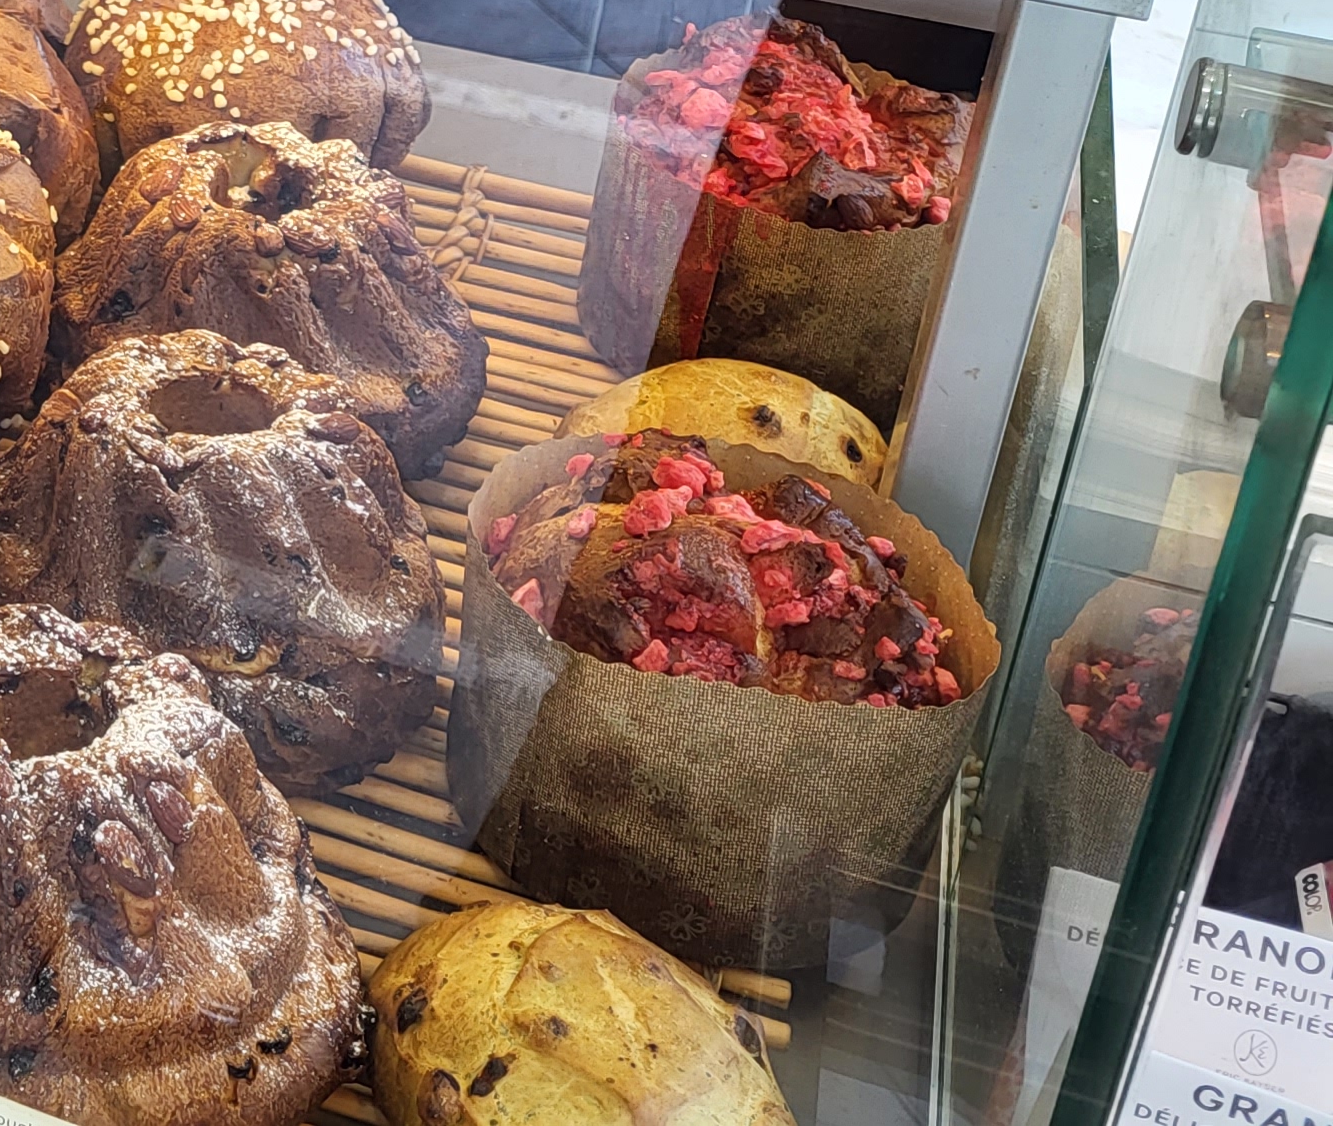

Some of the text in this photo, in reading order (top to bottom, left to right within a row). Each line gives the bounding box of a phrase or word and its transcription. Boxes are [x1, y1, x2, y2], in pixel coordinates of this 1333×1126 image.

[1067, 925, 1100, 947] DÉ
[1193, 919, 1333, 980] RANO
[1190, 985, 1333, 1038] TORRÉFIÉS
[1211, 964, 1246, 987] DE
[1255, 976, 1333, 1010] FRUIT
